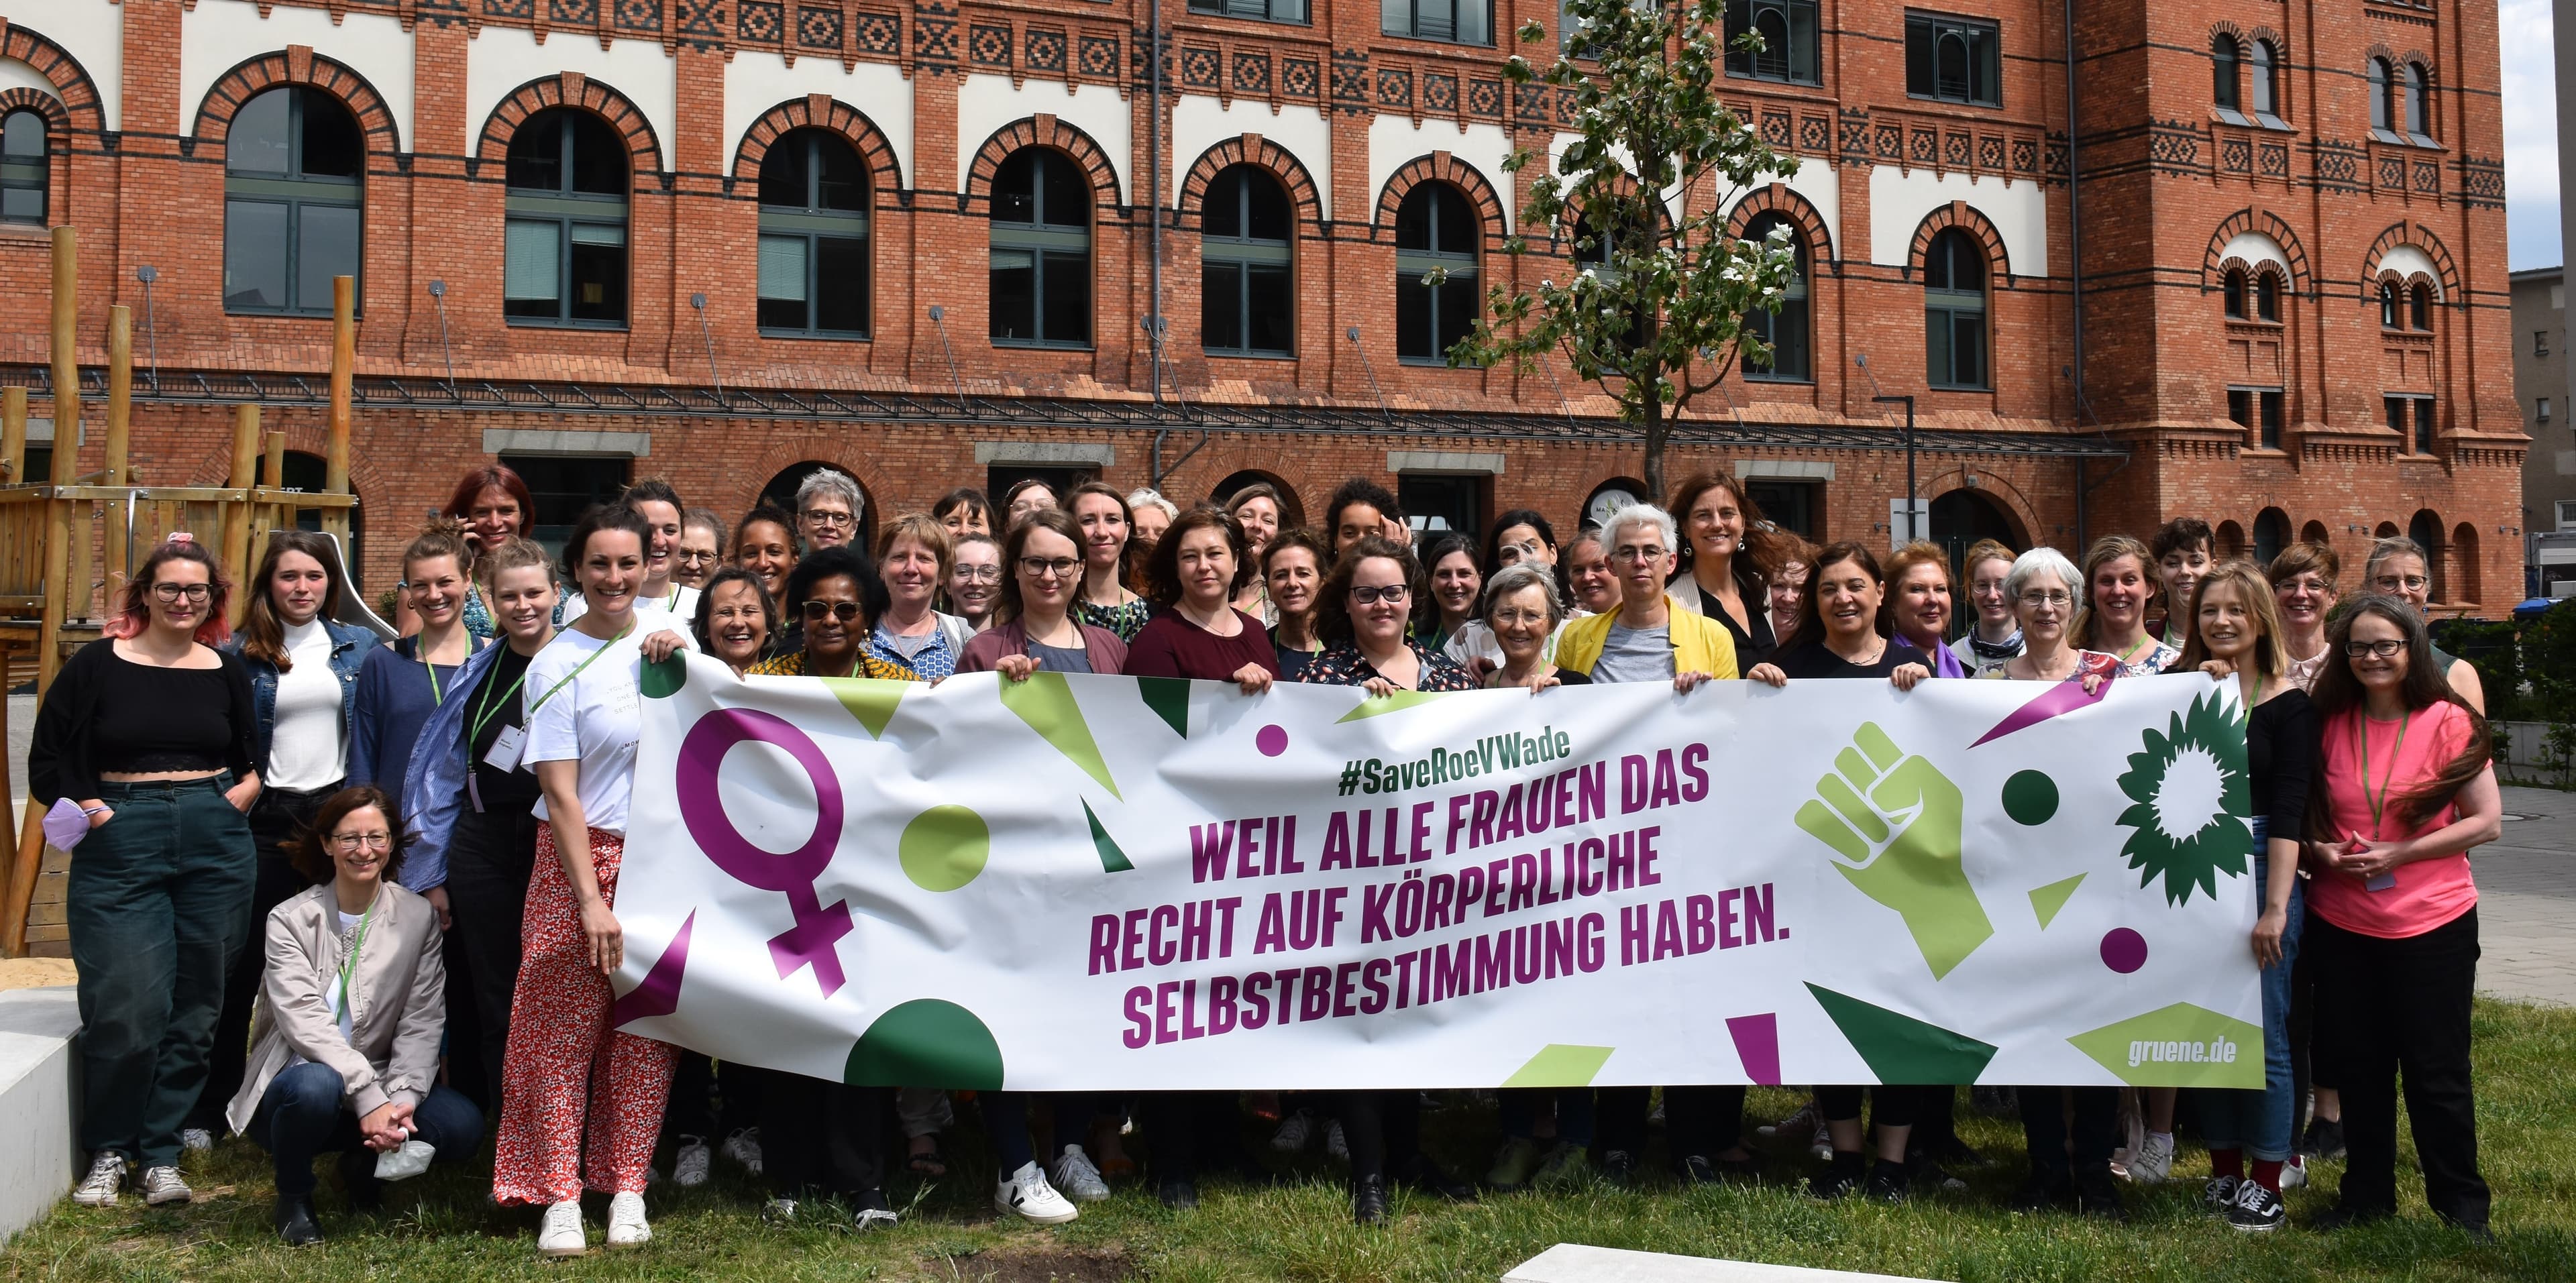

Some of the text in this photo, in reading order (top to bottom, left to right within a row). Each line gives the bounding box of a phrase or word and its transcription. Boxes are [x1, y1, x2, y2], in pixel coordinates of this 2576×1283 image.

[1189, 743, 1709, 884] WEIL ALLE FRAUEN DAS
[1338, 725, 1570, 796] #SaveRoeVWade
[1088, 826, 1661, 977] RECHT AUF KÖRPERLICHE
[1123, 883, 1790, 1049] SELBSTBESTIMMUNG HABEN.
[2127, 1035, 2237, 1068] gruene.de
